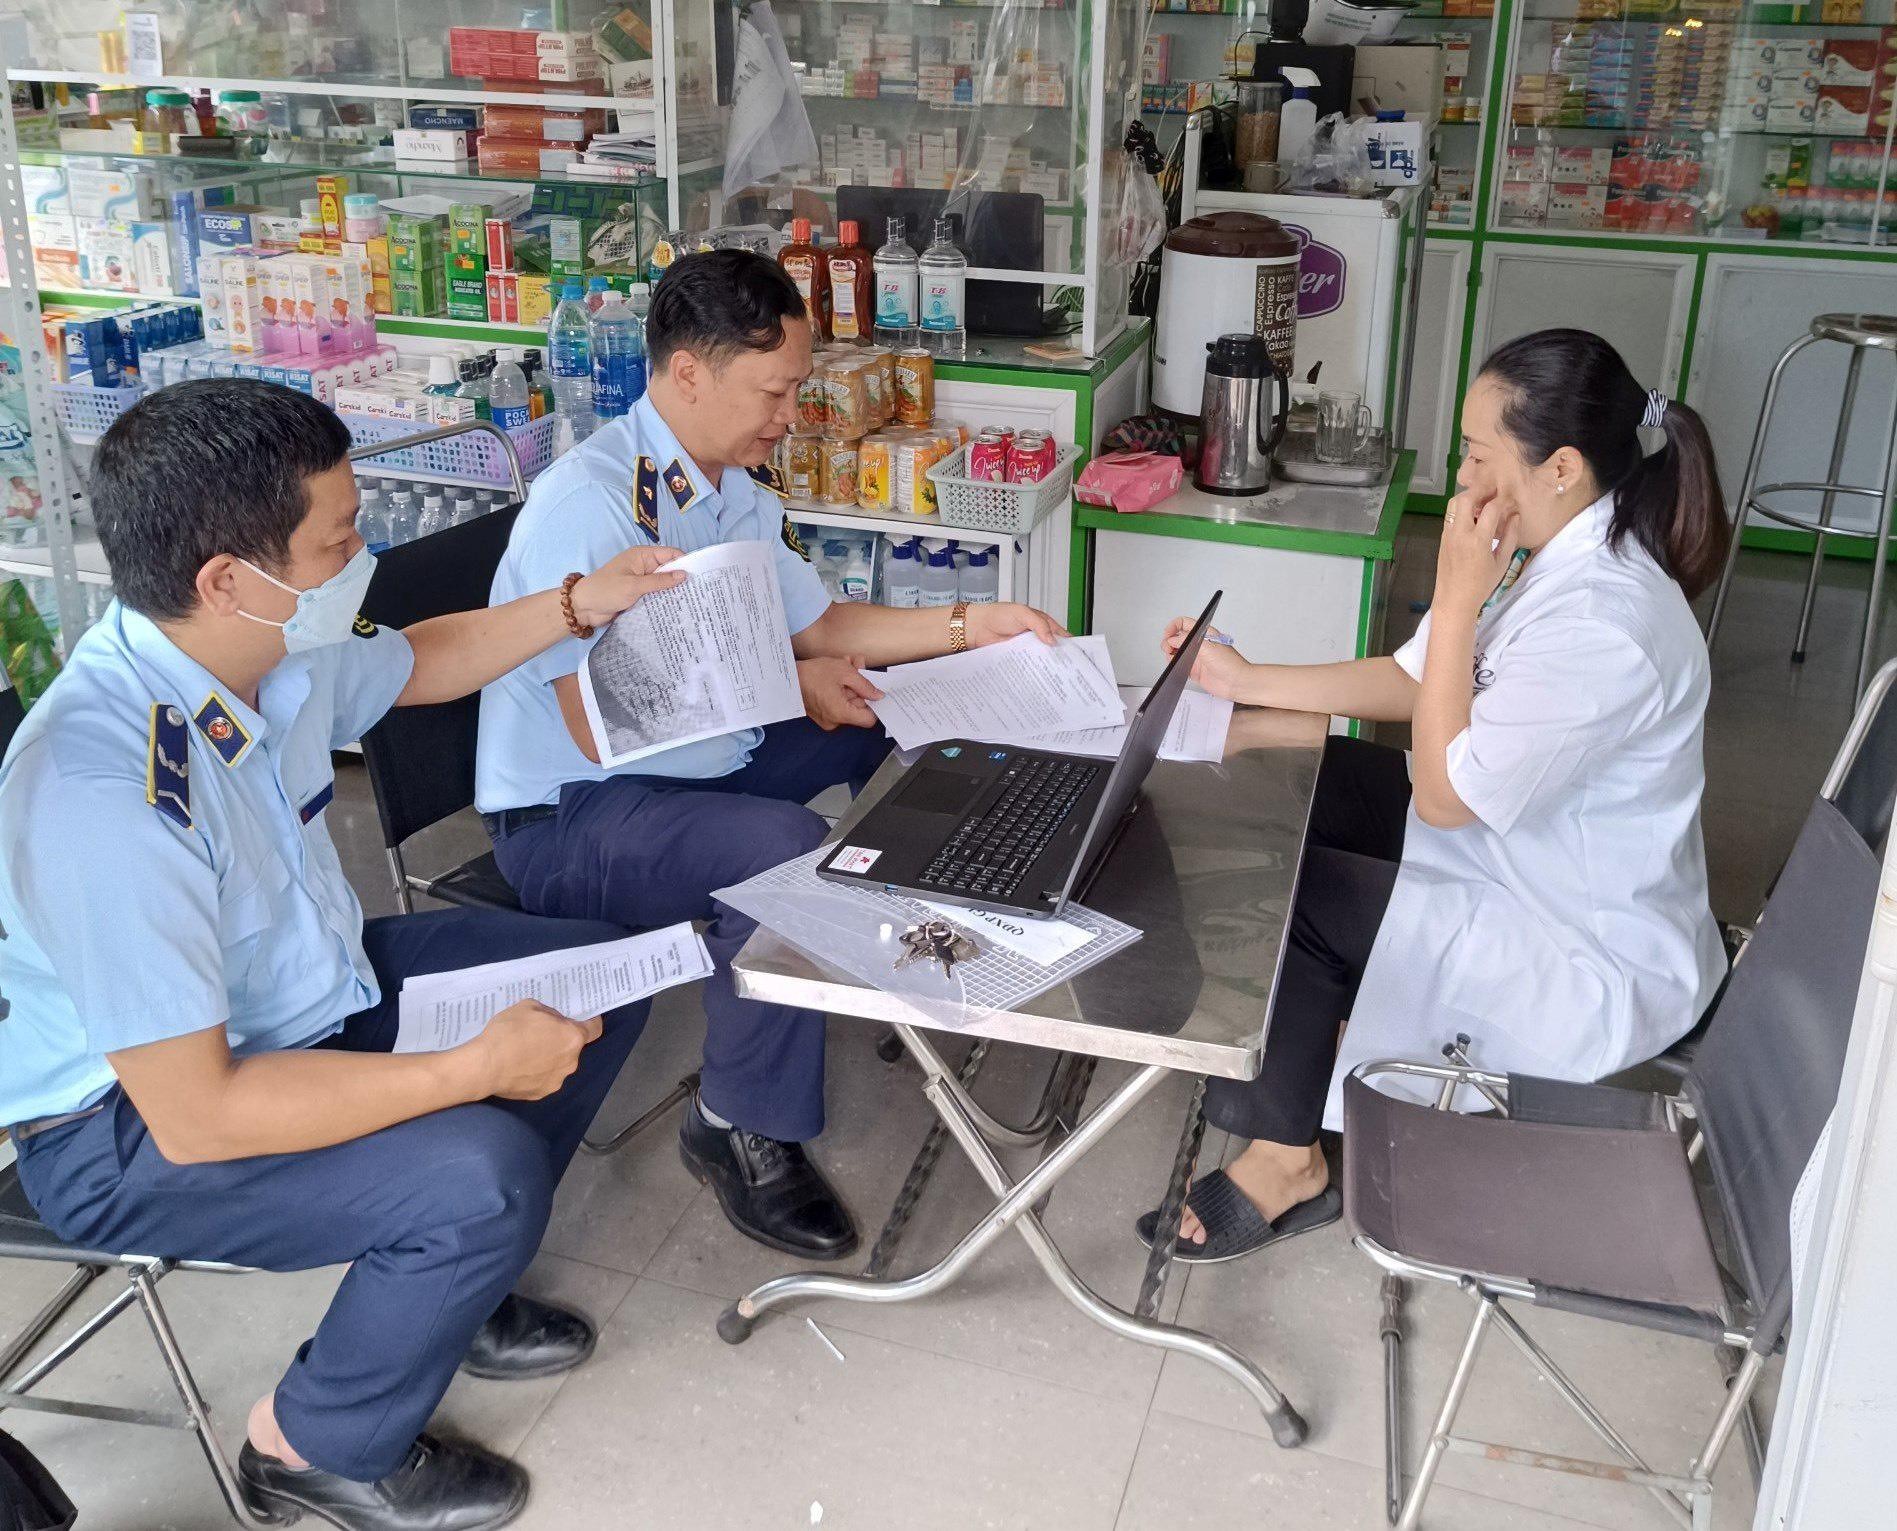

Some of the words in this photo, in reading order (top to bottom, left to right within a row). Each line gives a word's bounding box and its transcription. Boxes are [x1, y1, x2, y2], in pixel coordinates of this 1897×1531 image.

[1256, 276, 1265, 332] CAPPUCCINO
[1265, 276, 1275, 325] Espresso
[367, 405, 387, 414] Careki
